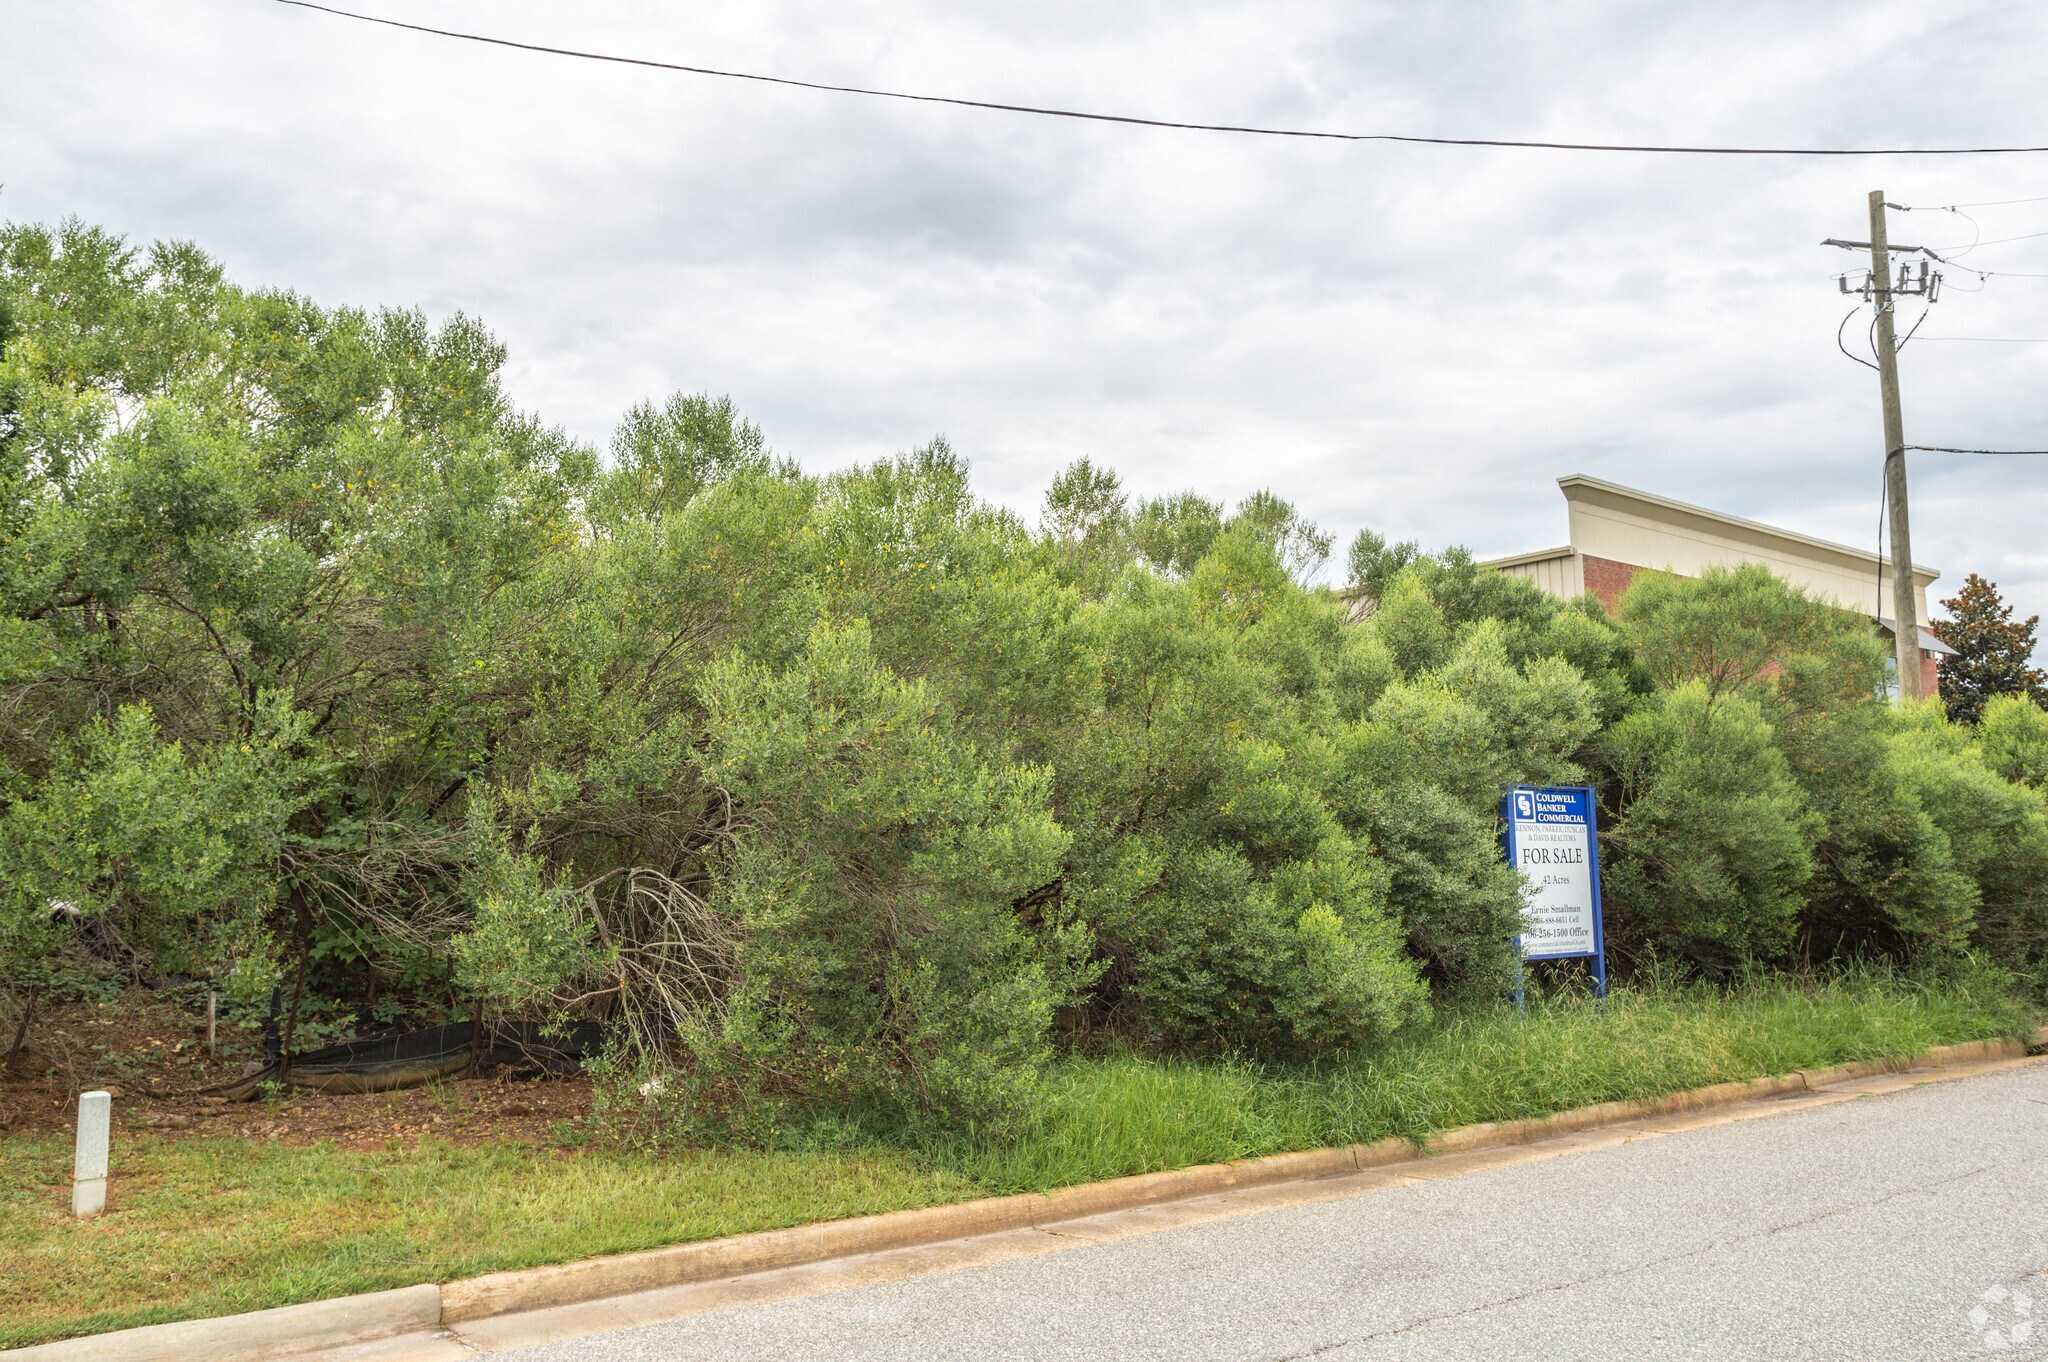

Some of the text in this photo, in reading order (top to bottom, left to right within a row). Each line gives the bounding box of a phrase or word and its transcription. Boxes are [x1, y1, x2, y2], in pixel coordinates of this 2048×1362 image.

[1536, 793, 1576, 803] COLDWELL
[1537, 803, 1567, 813] BANKER
[1538, 813, 1585, 823] COMMERCIAL
[1550, 834, 1576, 842] REALTORS
[1523, 848, 1583, 864] FOR SALE
[1541, 875, 1570, 884] .42 Acres
[1531, 904, 1581, 914] Ernie Smallman
[1569, 915, 1579, 923] Cell
[1569, 927, 1589, 936] Office
